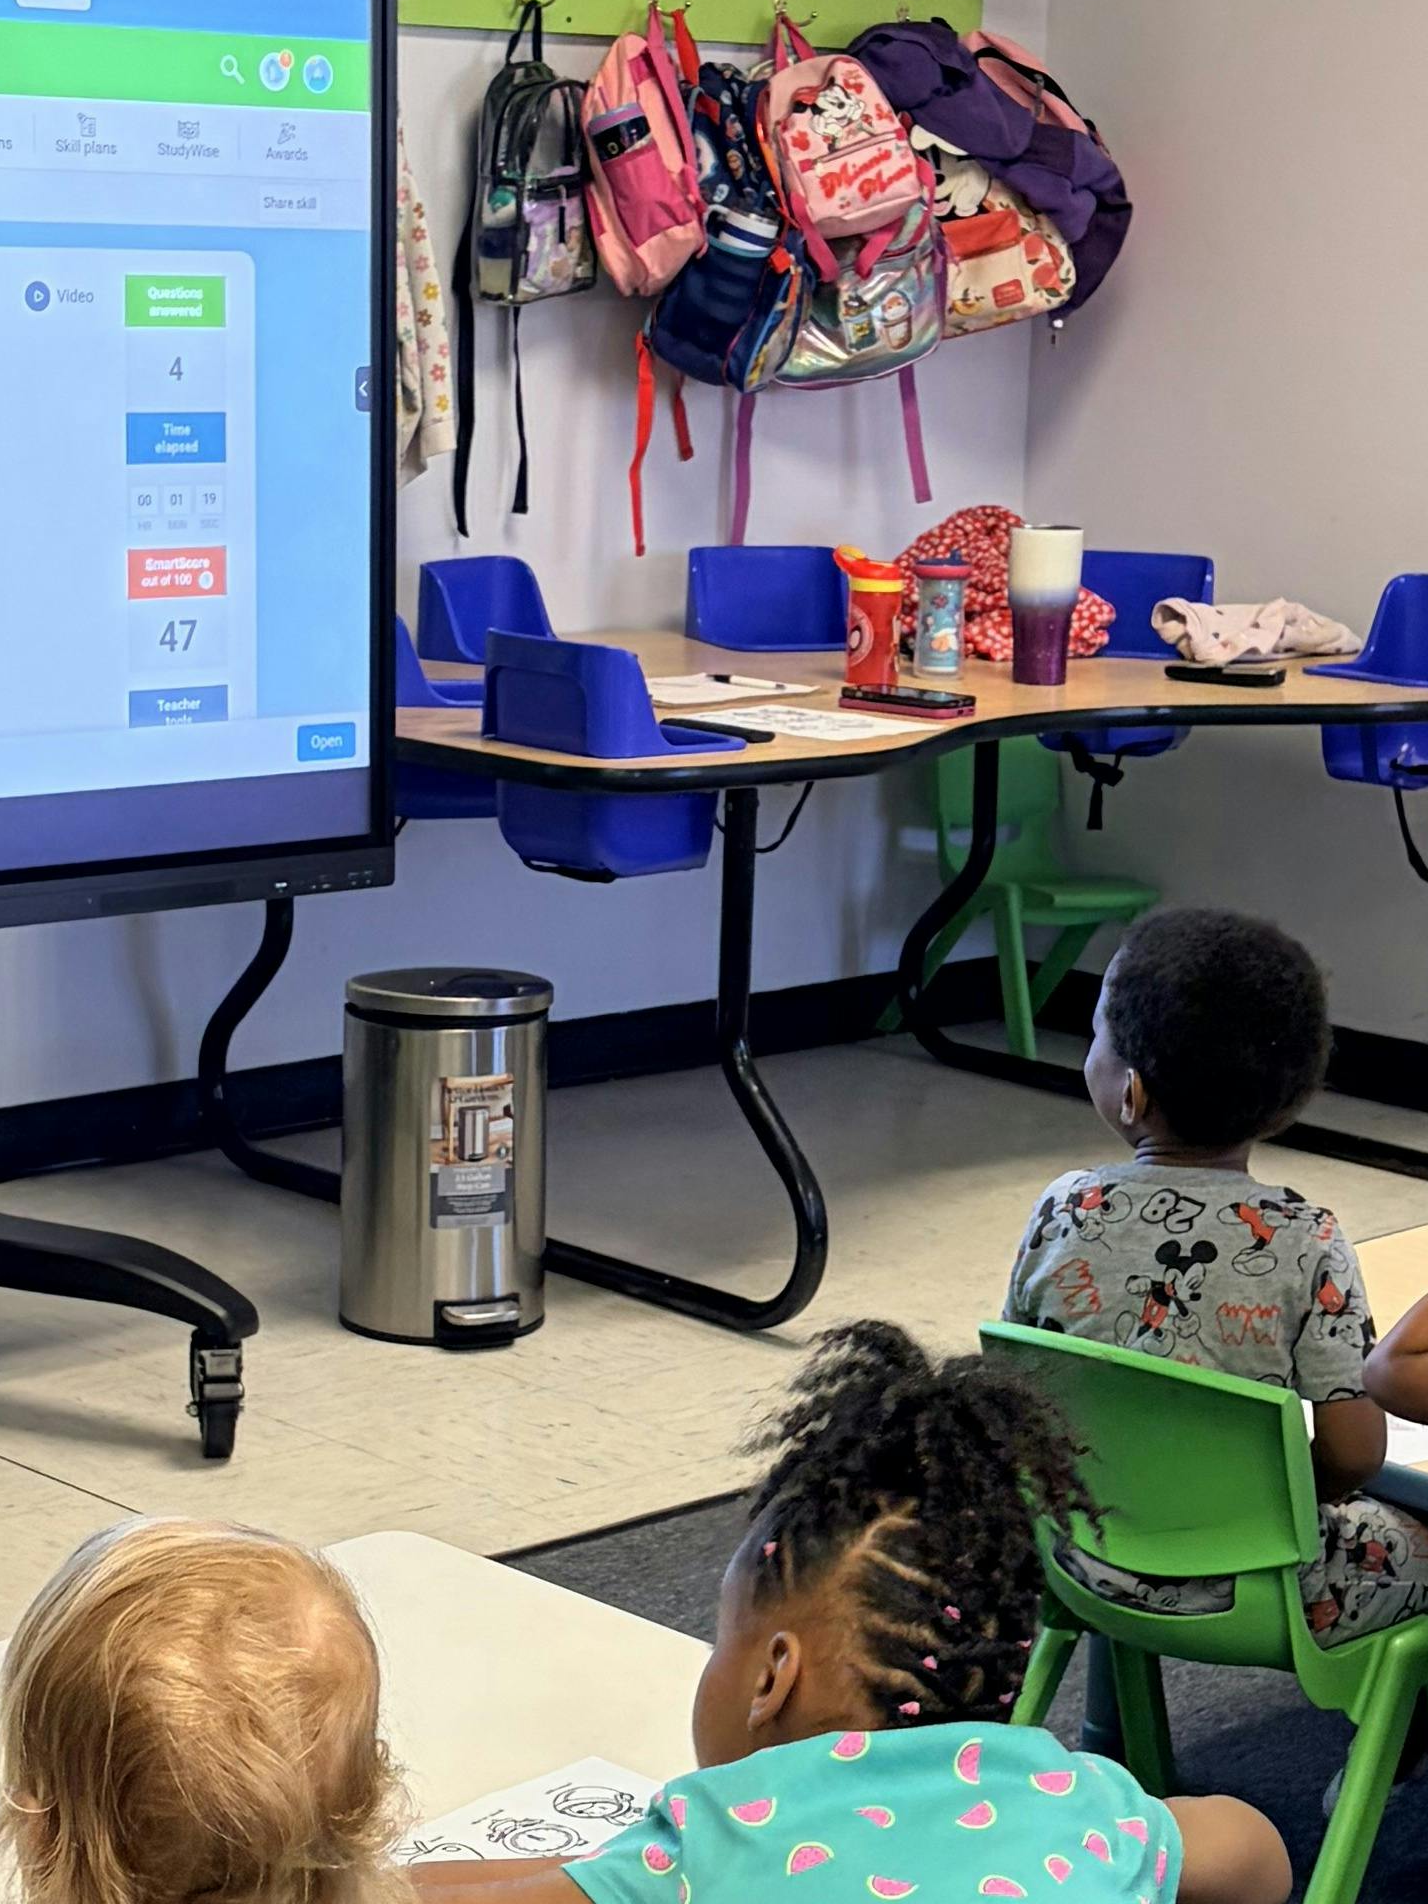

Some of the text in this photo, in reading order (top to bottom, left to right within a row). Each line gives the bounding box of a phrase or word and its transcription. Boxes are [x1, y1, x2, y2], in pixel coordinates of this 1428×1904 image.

[55, 139, 118, 157] Skill plans
[157, 143, 221, 159] StudyWise
[266, 147, 309, 162] Awards
[263, 195, 294, 210] Share
[56, 288, 95, 304] Video
[147, 285, 204, 301] Questions
[168, 355, 184, 382] 4
[162, 422, 191, 437] Time
[154, 439, 199, 456] elapsed
[136, 494, 153, 507] 00
[169, 493, 184, 507] 01
[202, 492, 217, 506] 19
[144, 556, 211, 572] SmartScore
[140, 572, 193, 588] out of 100
[158, 618, 198, 653] 47
[156, 697, 202, 713] Teacher
[309, 733, 344, 752] Open
